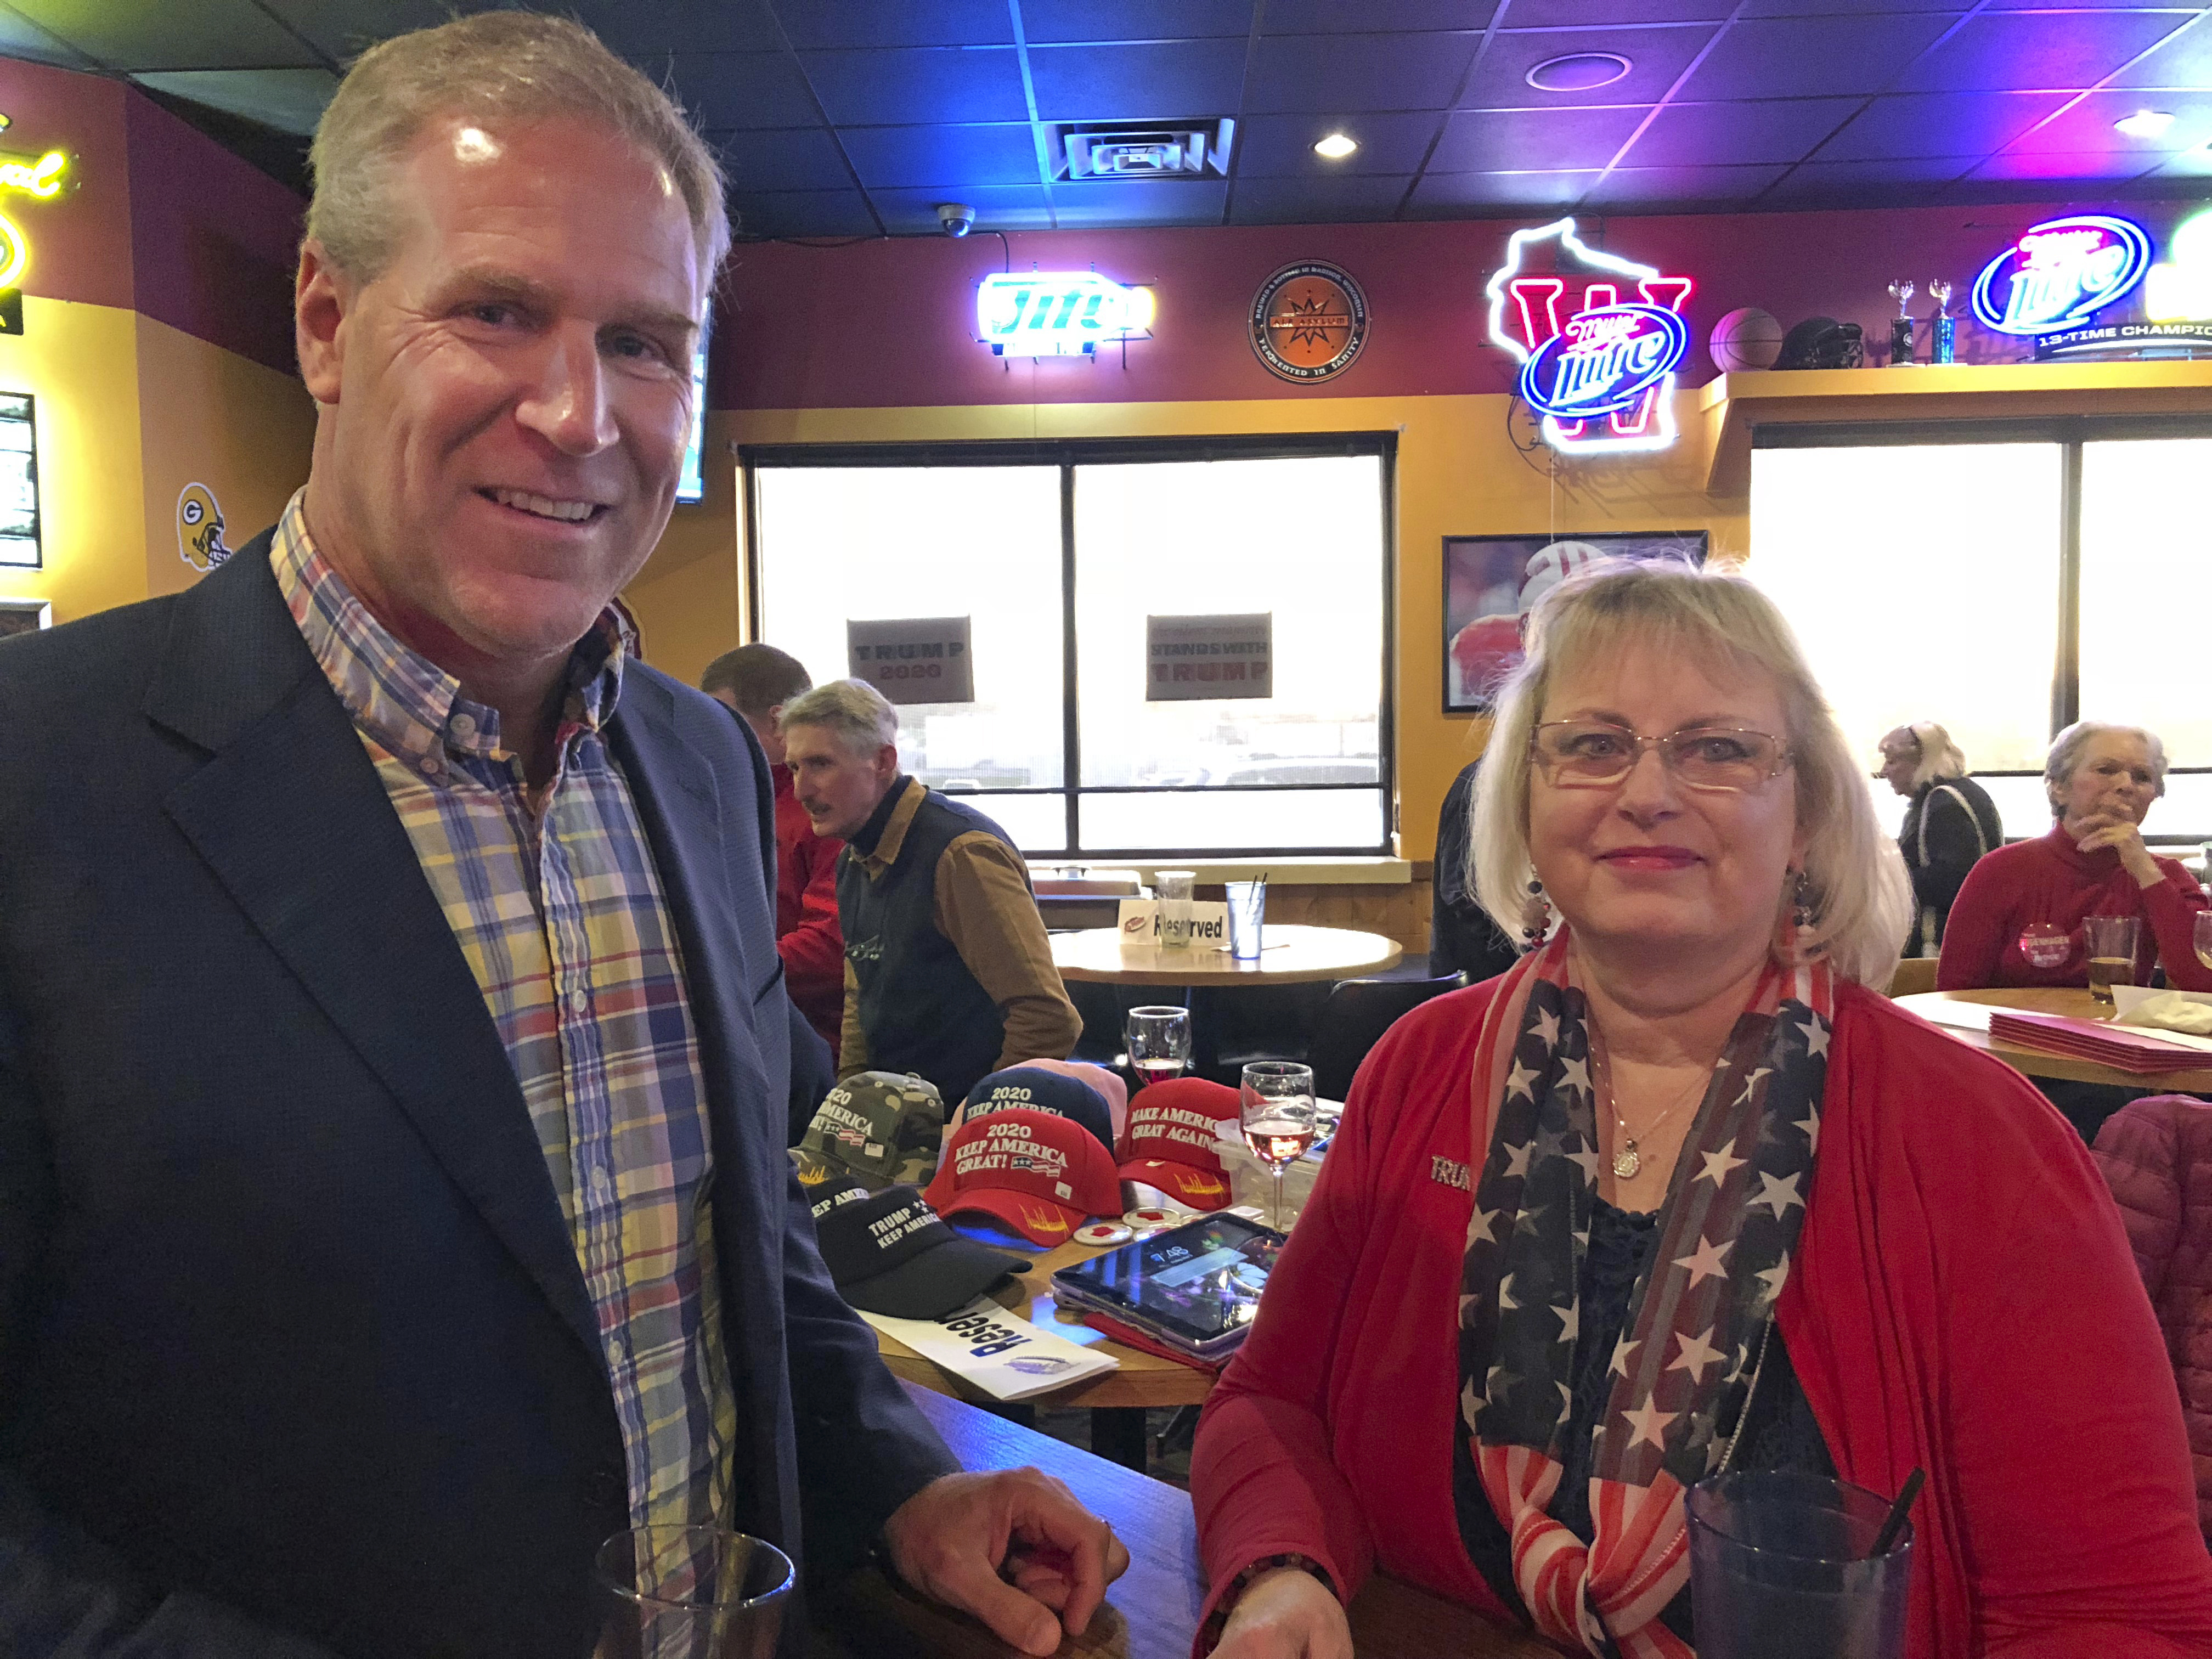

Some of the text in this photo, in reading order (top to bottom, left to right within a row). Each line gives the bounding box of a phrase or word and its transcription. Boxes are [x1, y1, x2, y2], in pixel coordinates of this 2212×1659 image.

[1255, 289, 1270, 319] BREWED
[1342, 280, 1364, 318] WISCONSIN
[2039, 327, 2117, 347] 13-TIME
[1259, 336, 1360, 376] FERMENTED IN SANITY
[1549, 331, 1666, 407] Lite
[183, 500, 202, 524] G
[855, 642, 964, 661] TRUMP
[1151, 642, 1268, 656] STANDS WITH
[879, 664, 941, 680] 2020
[1151, 661, 1268, 682] TRUMP
[991, 1087, 1031, 1101] 2020
[1130, 1107, 1160, 1124] MAKE
[986, 1123, 1032, 1138] 2020
[1132, 1124, 1216, 1151] GREAT AGAIN
[954, 1138, 1068, 1168] KEEP AMERICA
[956, 1154, 1007, 1175] GREAT!
[868, 1207, 911, 1237] TRUMP
[877, 1228, 903, 1249] KEEP
